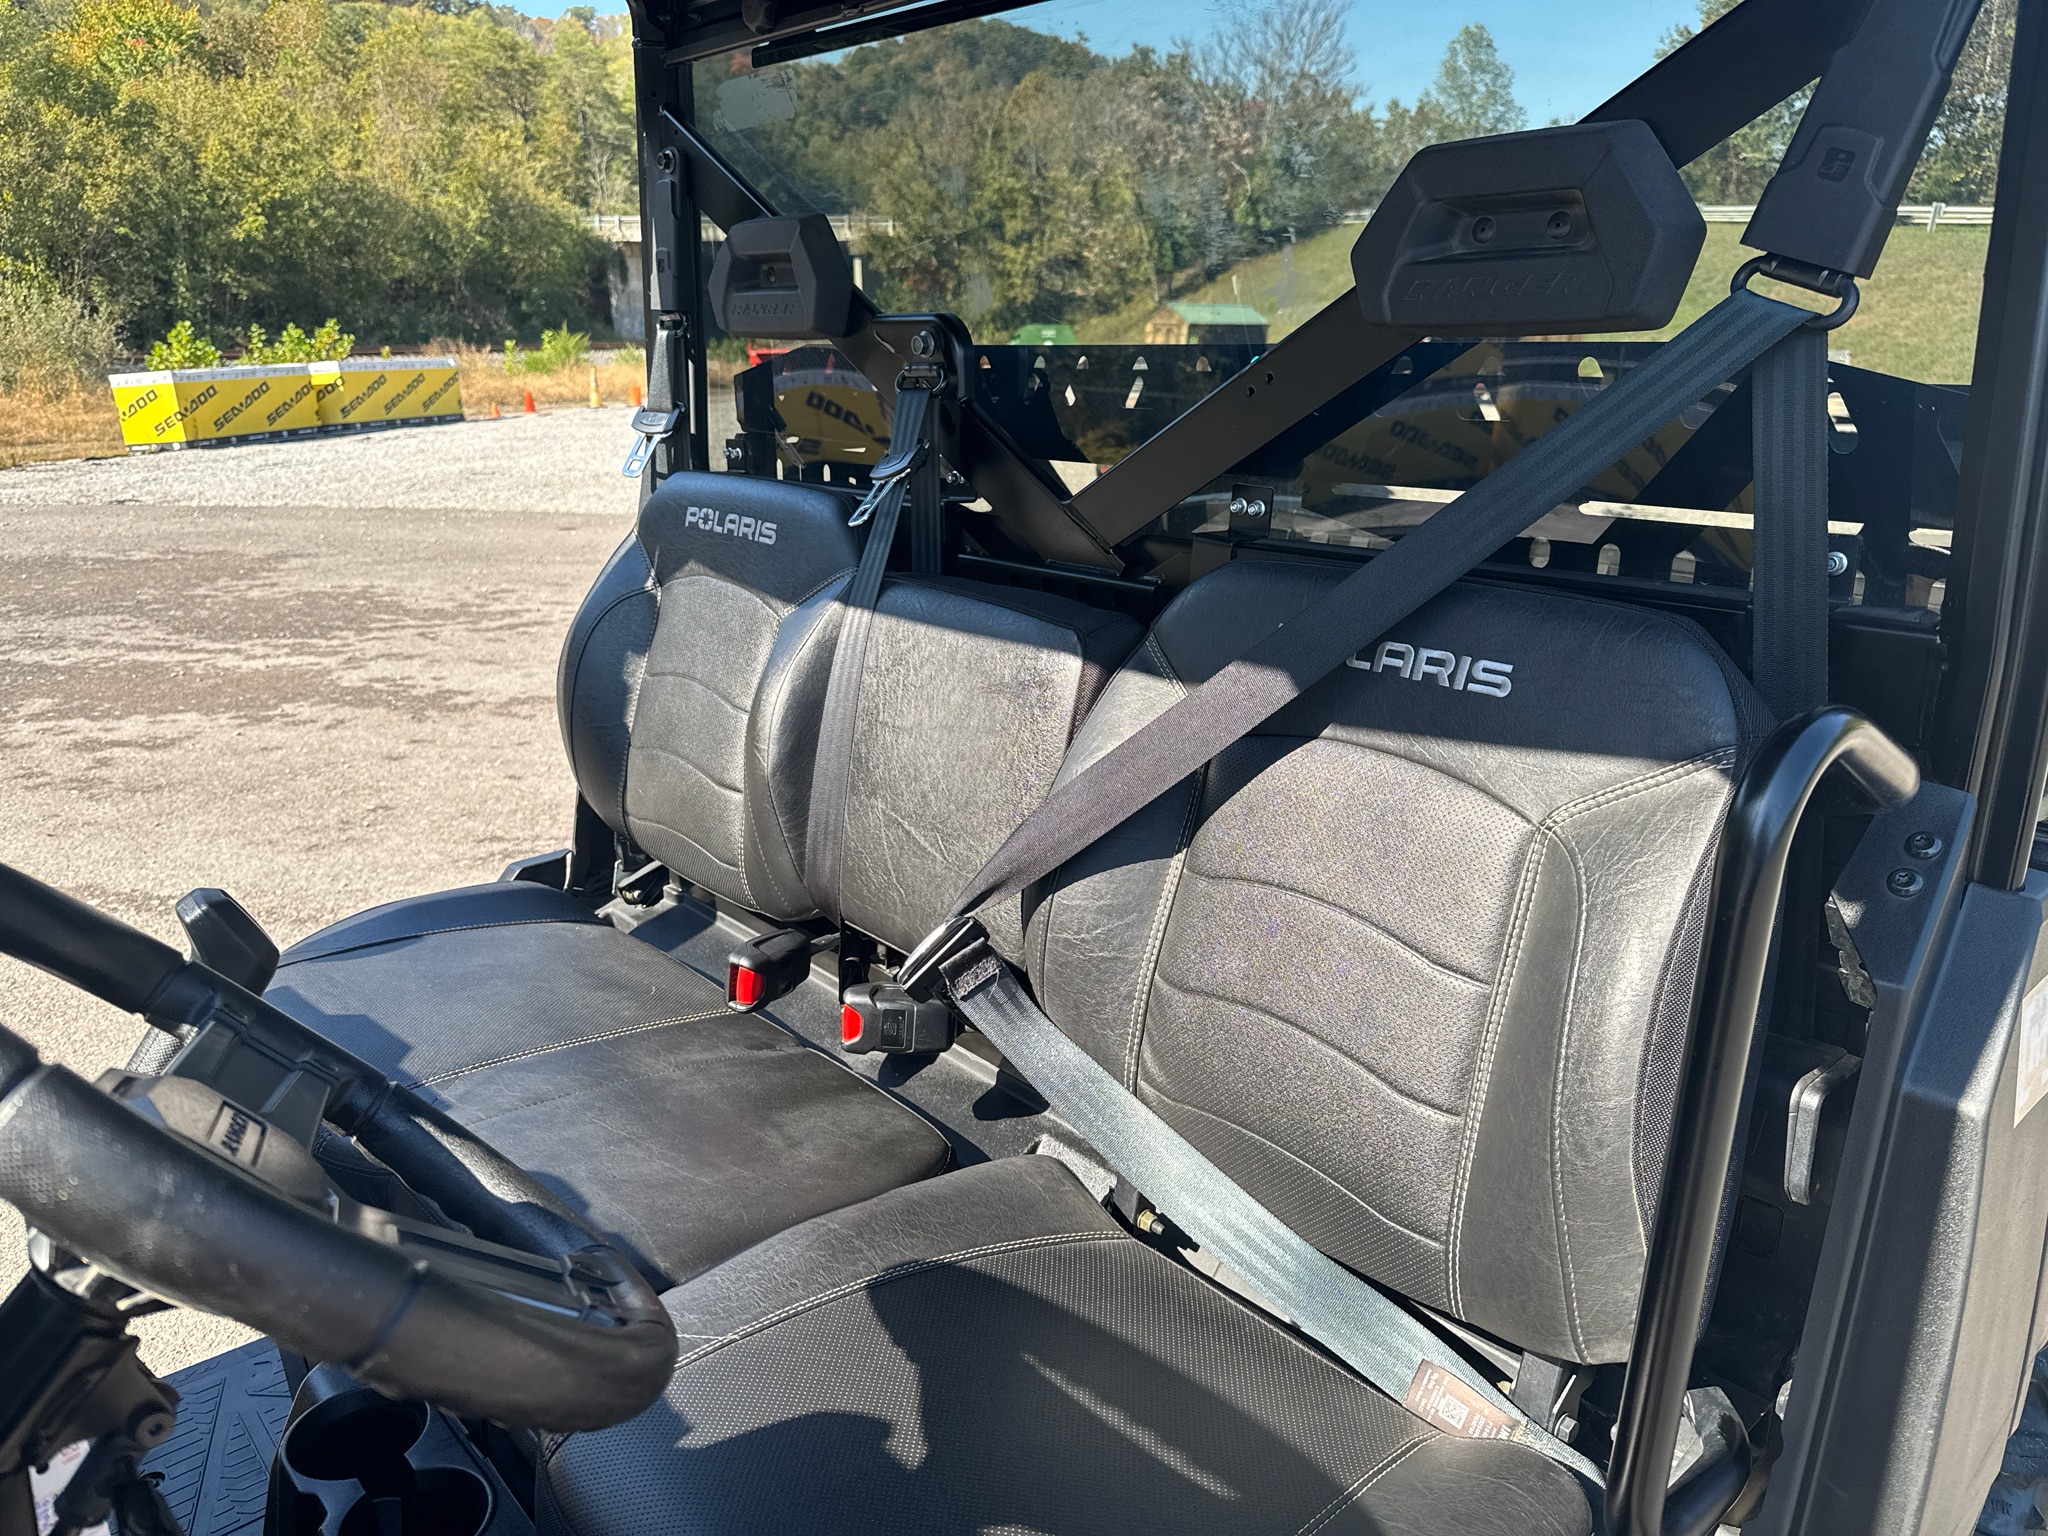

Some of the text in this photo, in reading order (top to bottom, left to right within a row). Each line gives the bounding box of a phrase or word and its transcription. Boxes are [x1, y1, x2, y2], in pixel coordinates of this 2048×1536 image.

[731, 302, 796, 316] RANGER
[685, 506, 777, 545] POLARIS
[1346, 641, 1513, 698] LARIS
